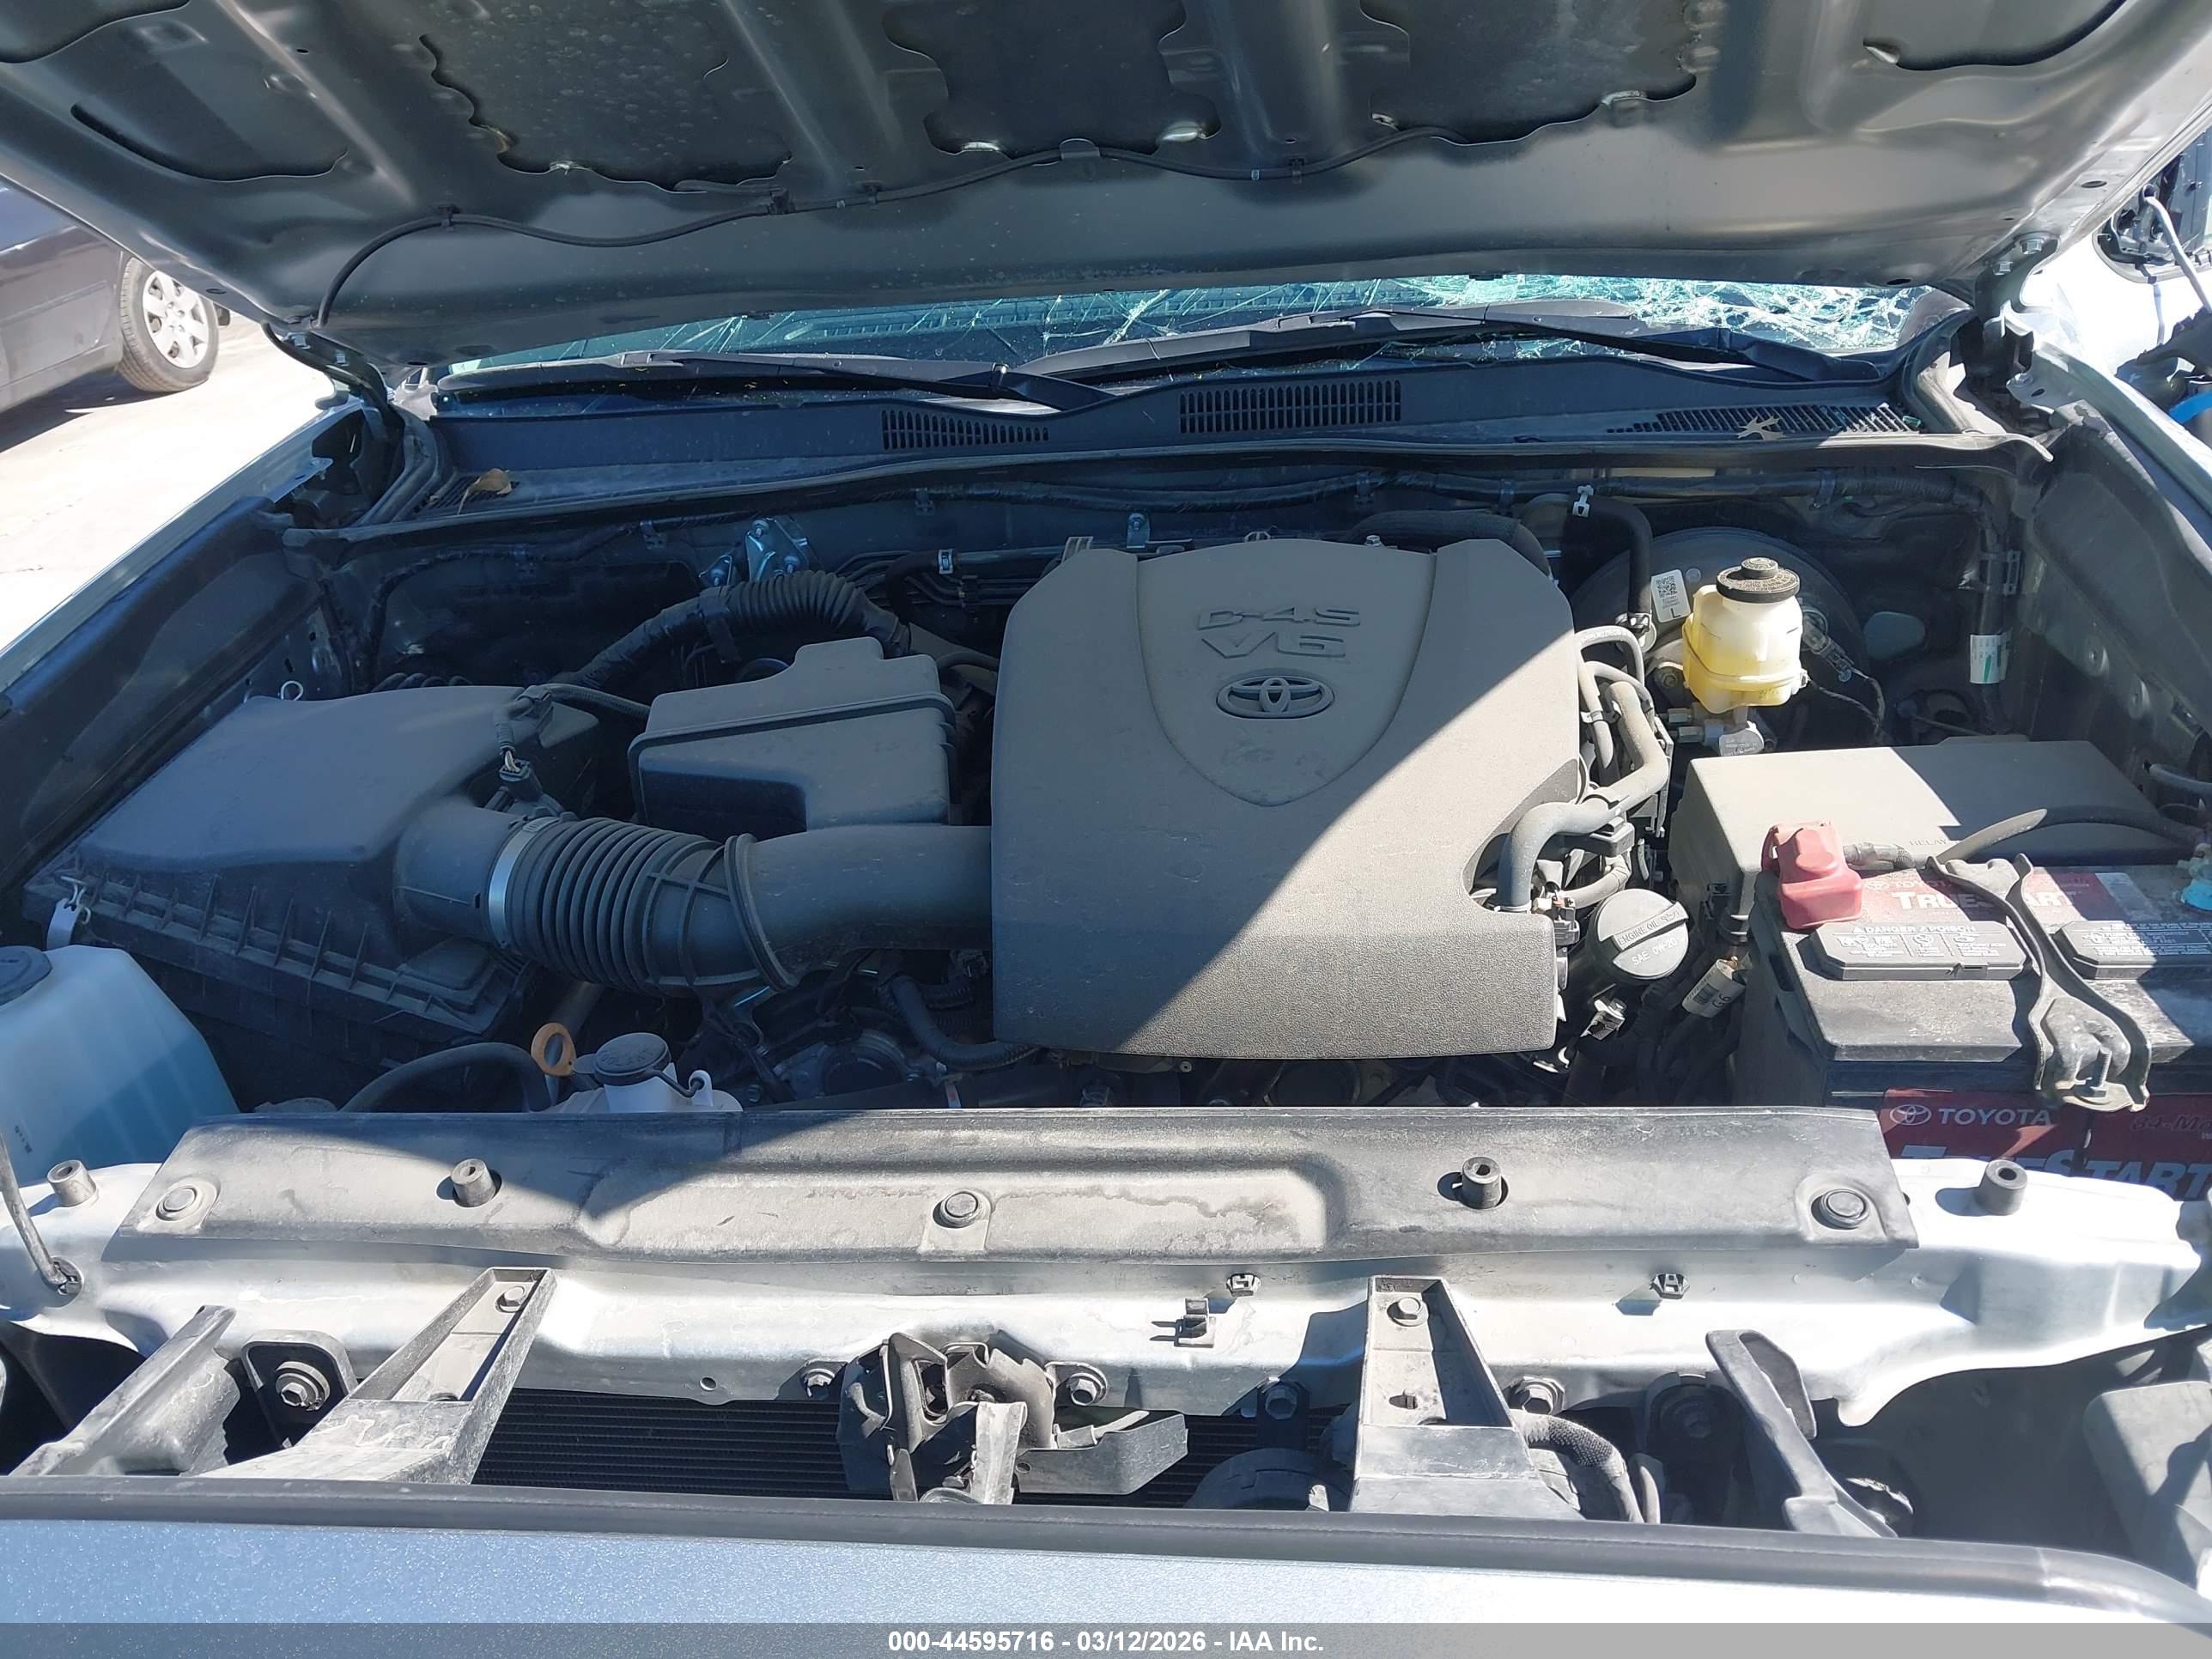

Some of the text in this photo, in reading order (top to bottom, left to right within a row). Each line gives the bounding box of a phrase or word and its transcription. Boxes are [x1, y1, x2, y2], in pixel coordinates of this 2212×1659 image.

[1197, 606, 1361, 631] D-4S
[1201, 632, 1346, 659] V6
[1618, 920, 1660, 945] ENGINE OIL
[1632, 950, 1650, 966] SAE
[1937, 1108, 2054, 1127] TOYOTA
